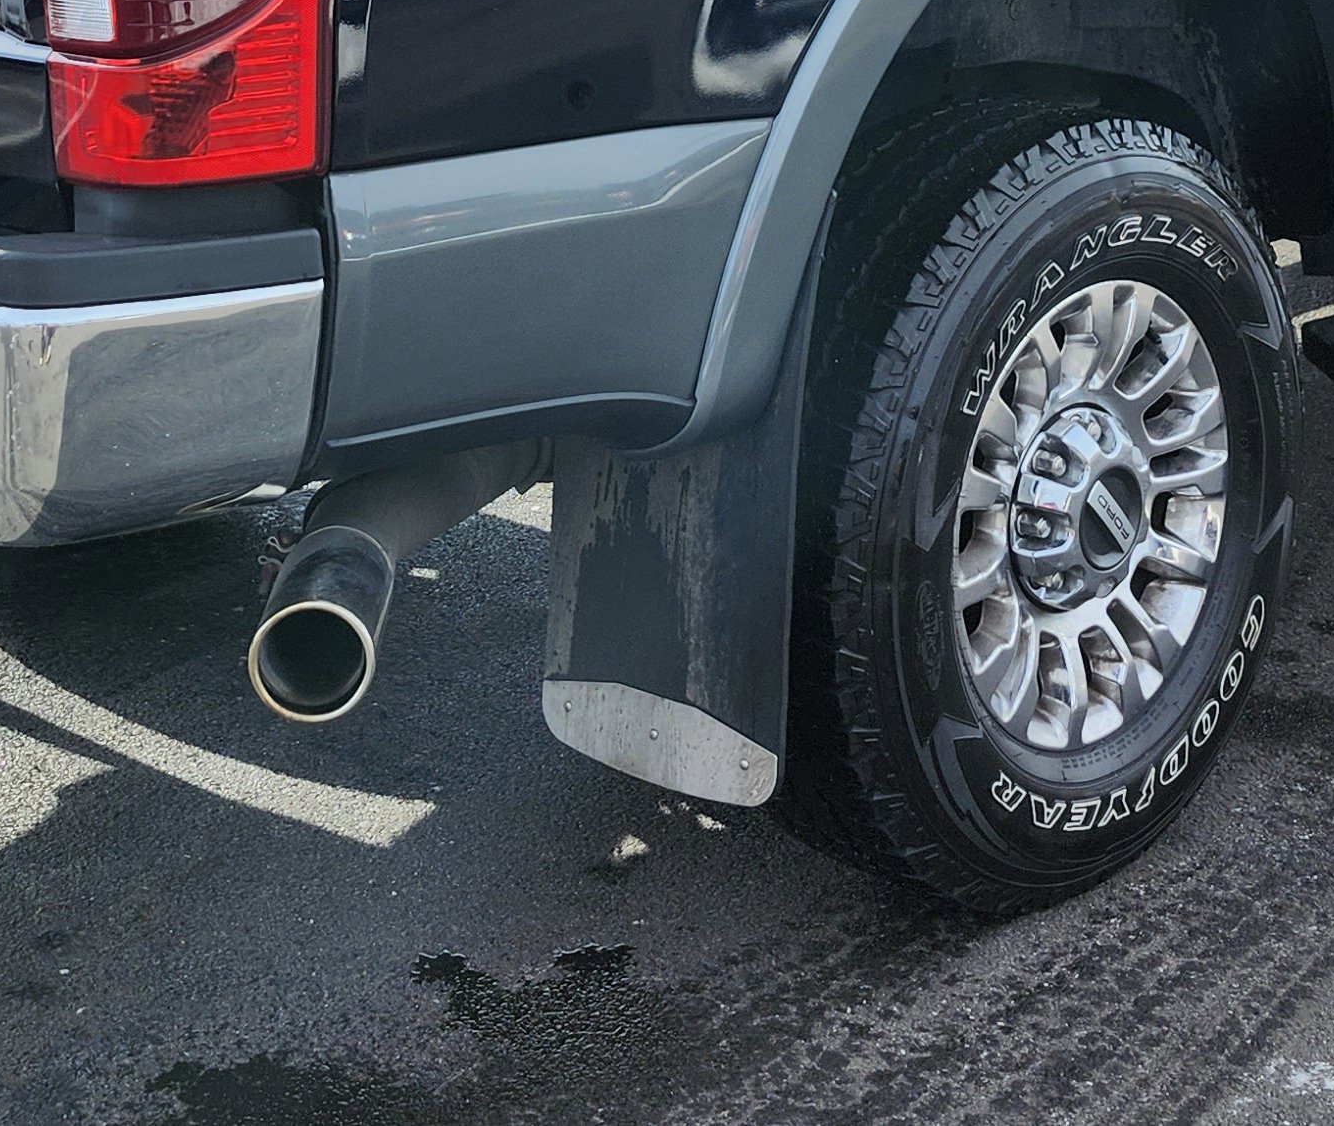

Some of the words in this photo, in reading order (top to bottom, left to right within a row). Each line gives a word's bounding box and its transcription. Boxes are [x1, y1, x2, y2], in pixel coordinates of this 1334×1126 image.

[961, 214, 1239, 416] WRANGLER
[1097, 494, 1130, 540] FORD
[990, 594, 1265, 832] GOODYEAR
